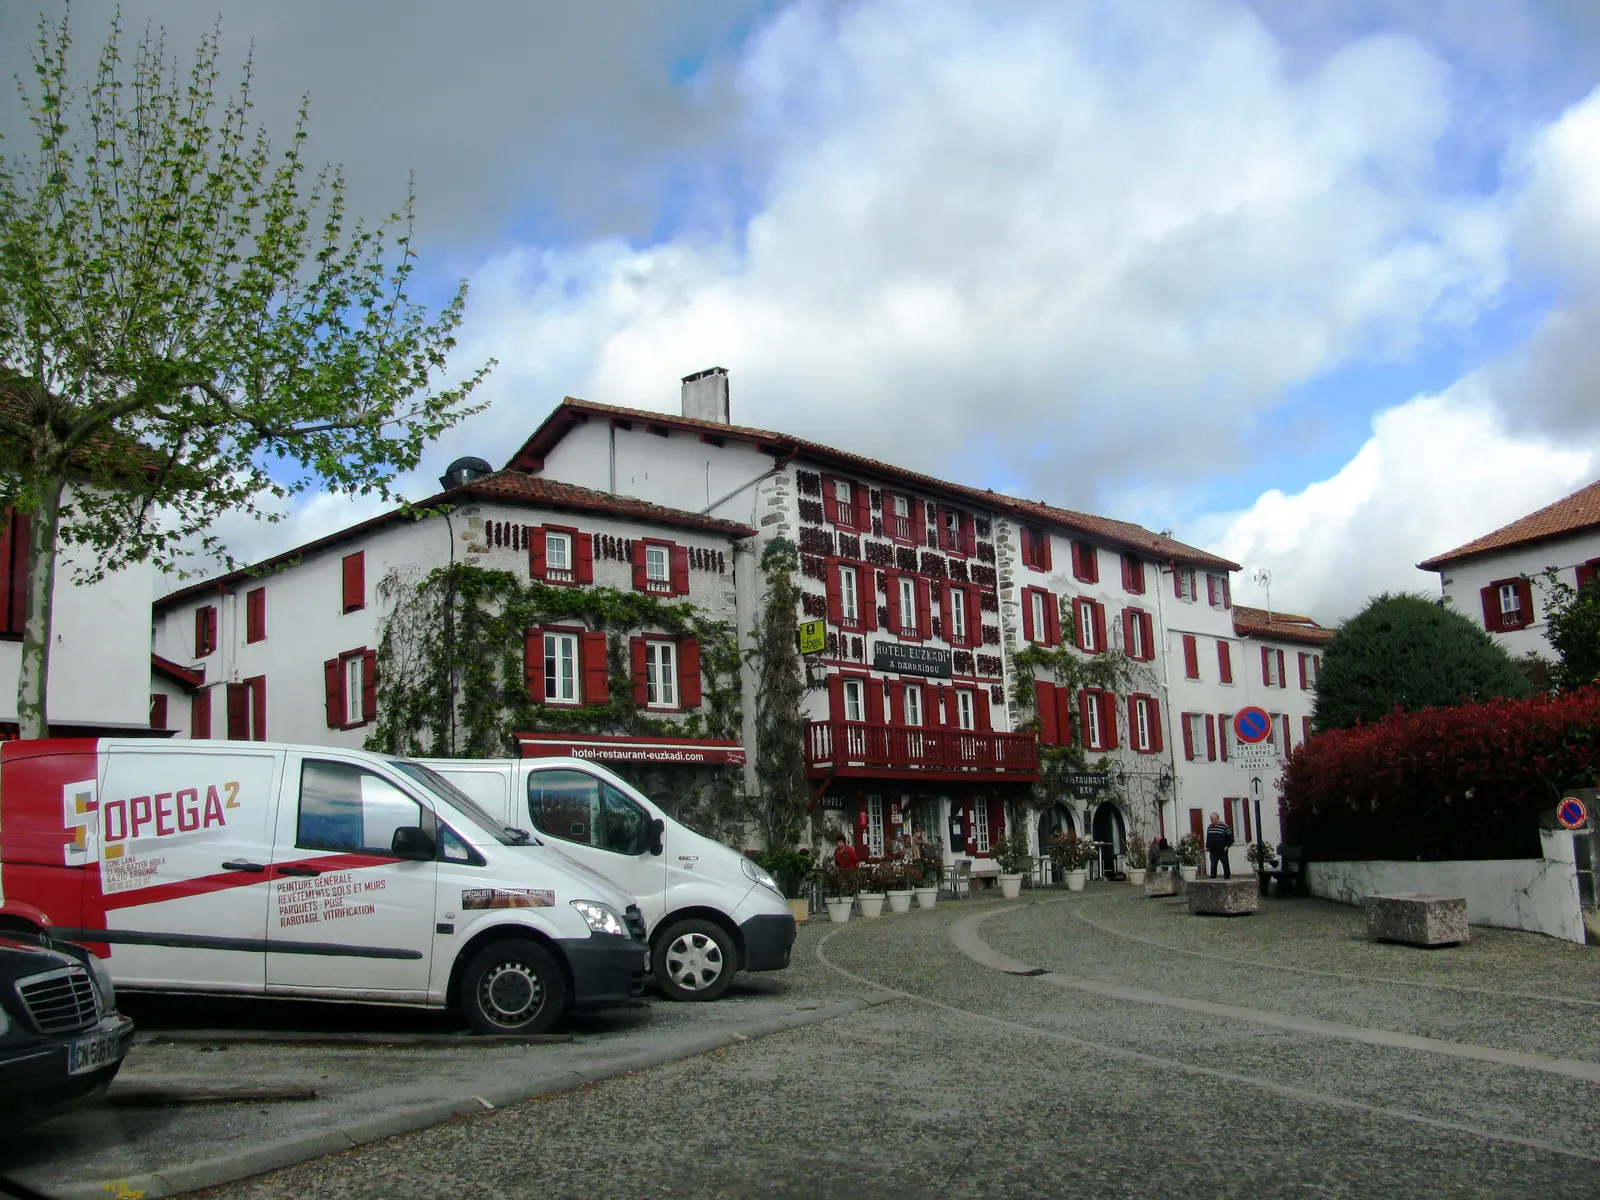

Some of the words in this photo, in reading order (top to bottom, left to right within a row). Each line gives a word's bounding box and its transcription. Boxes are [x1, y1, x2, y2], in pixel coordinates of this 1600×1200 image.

[876, 643, 906, 658] HOTEL
[890, 660, 896, 669] A
[571, 747, 704, 761] hotel-restaurant-euzkadi.com
[107, 872, 128, 884] 64210
[130, 866, 158, 878] ARBONNE
[277, 880, 313, 893] PEINTURE
[314, 874, 352, 888] GÉNÉRALE
[278, 888, 330, 905] REVÊTEMENTS
[332, 885, 352, 897] SOLS
[354, 883, 362, 893] ET
[364, 880, 386, 892] MURS
[279, 901, 318, 915] PARQUETS
[324, 897, 344, 909] POSE
[280, 913, 321, 928] RABOTAGE,
[323, 904, 375, 921] VITRIFICATION
